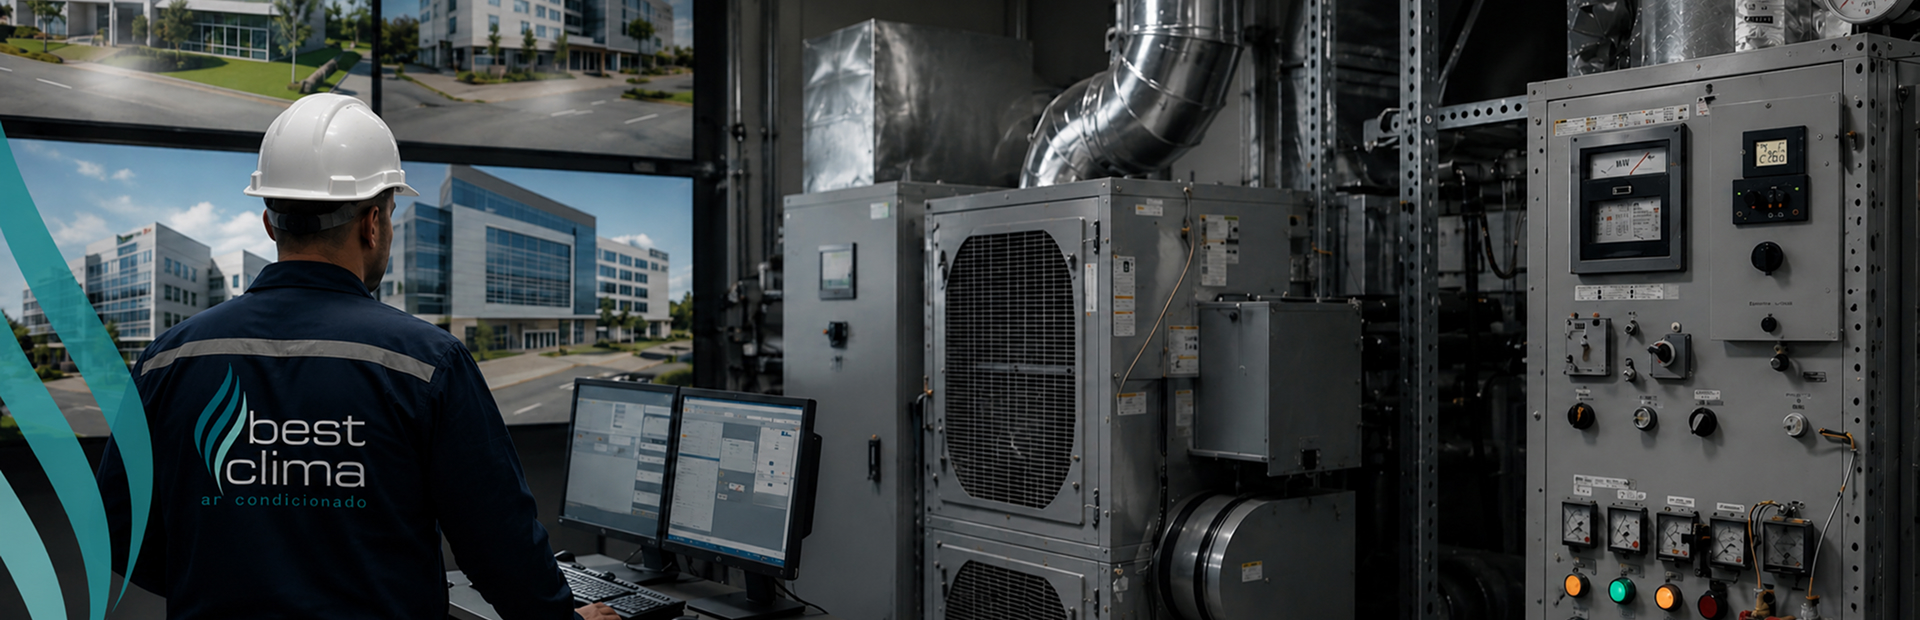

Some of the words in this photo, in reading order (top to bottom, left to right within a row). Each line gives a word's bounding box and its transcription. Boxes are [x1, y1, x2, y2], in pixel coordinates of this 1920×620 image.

[249, 410, 366, 447] best
[226, 449, 366, 488] clima
[201, 495, 223, 506] ar
[235, 493, 367, 508] condicionado
